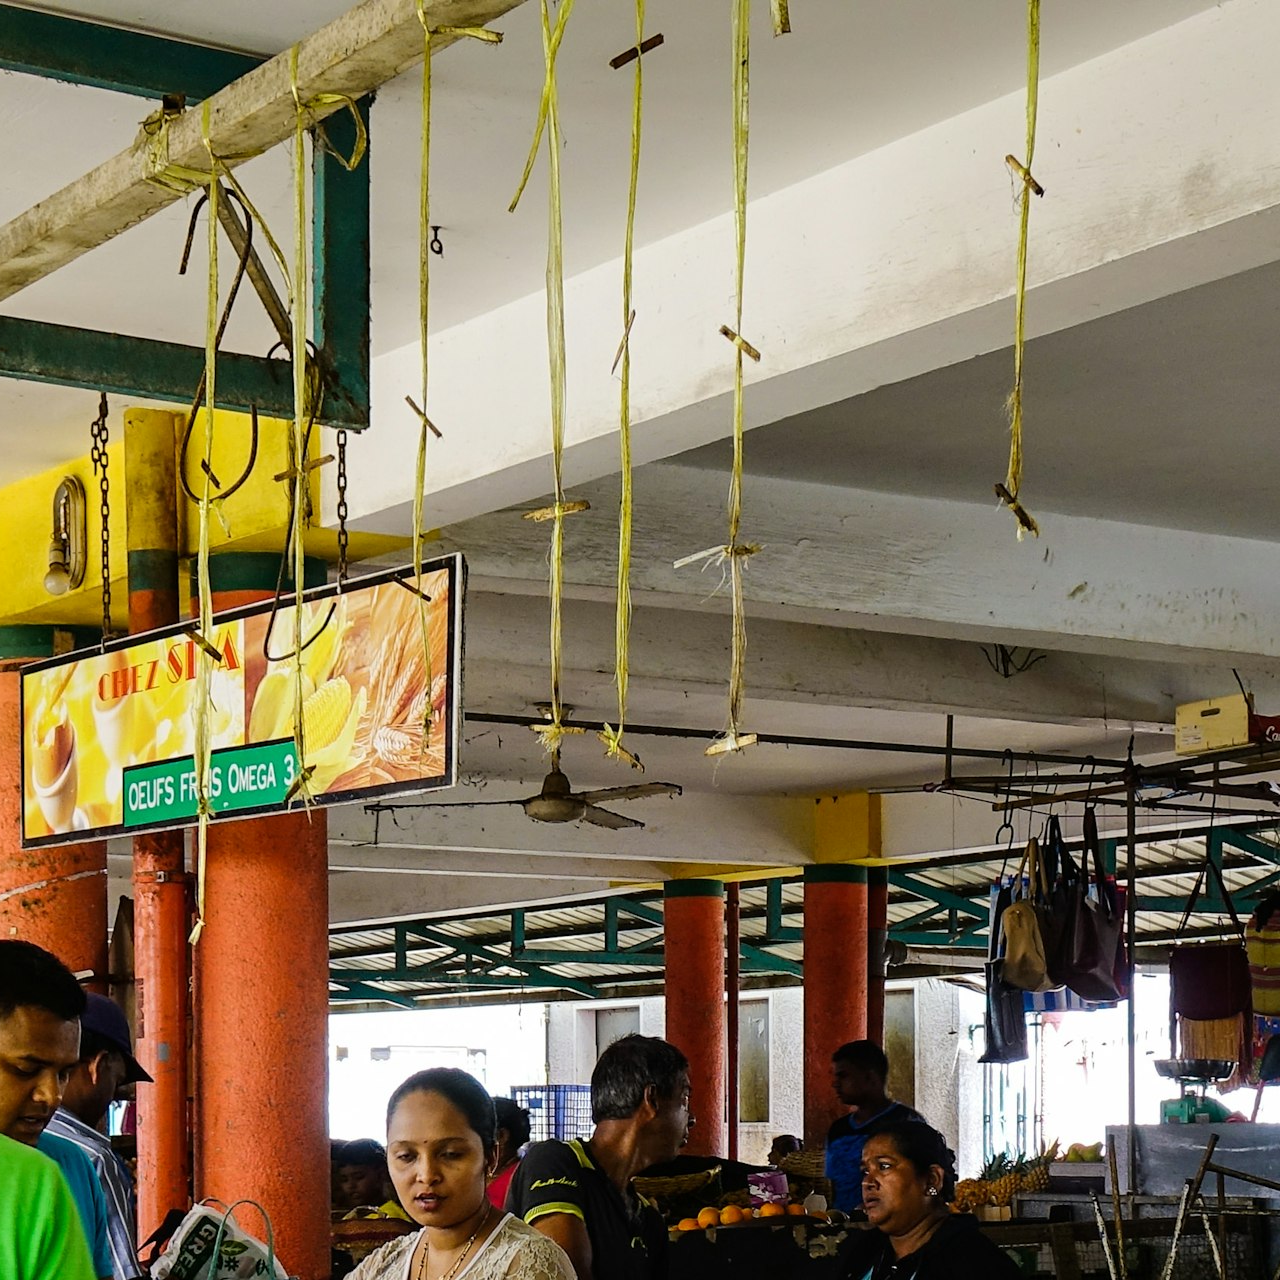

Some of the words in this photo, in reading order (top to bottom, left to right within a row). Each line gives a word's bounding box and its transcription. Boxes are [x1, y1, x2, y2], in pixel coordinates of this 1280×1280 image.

[98, 660, 159, 702] CHEZ
[166, 629, 240, 684] SIA
[128, 775, 174, 812] OEUFS
[180, 766, 221, 802] FRIS
[284, 754, 294, 786] 3
